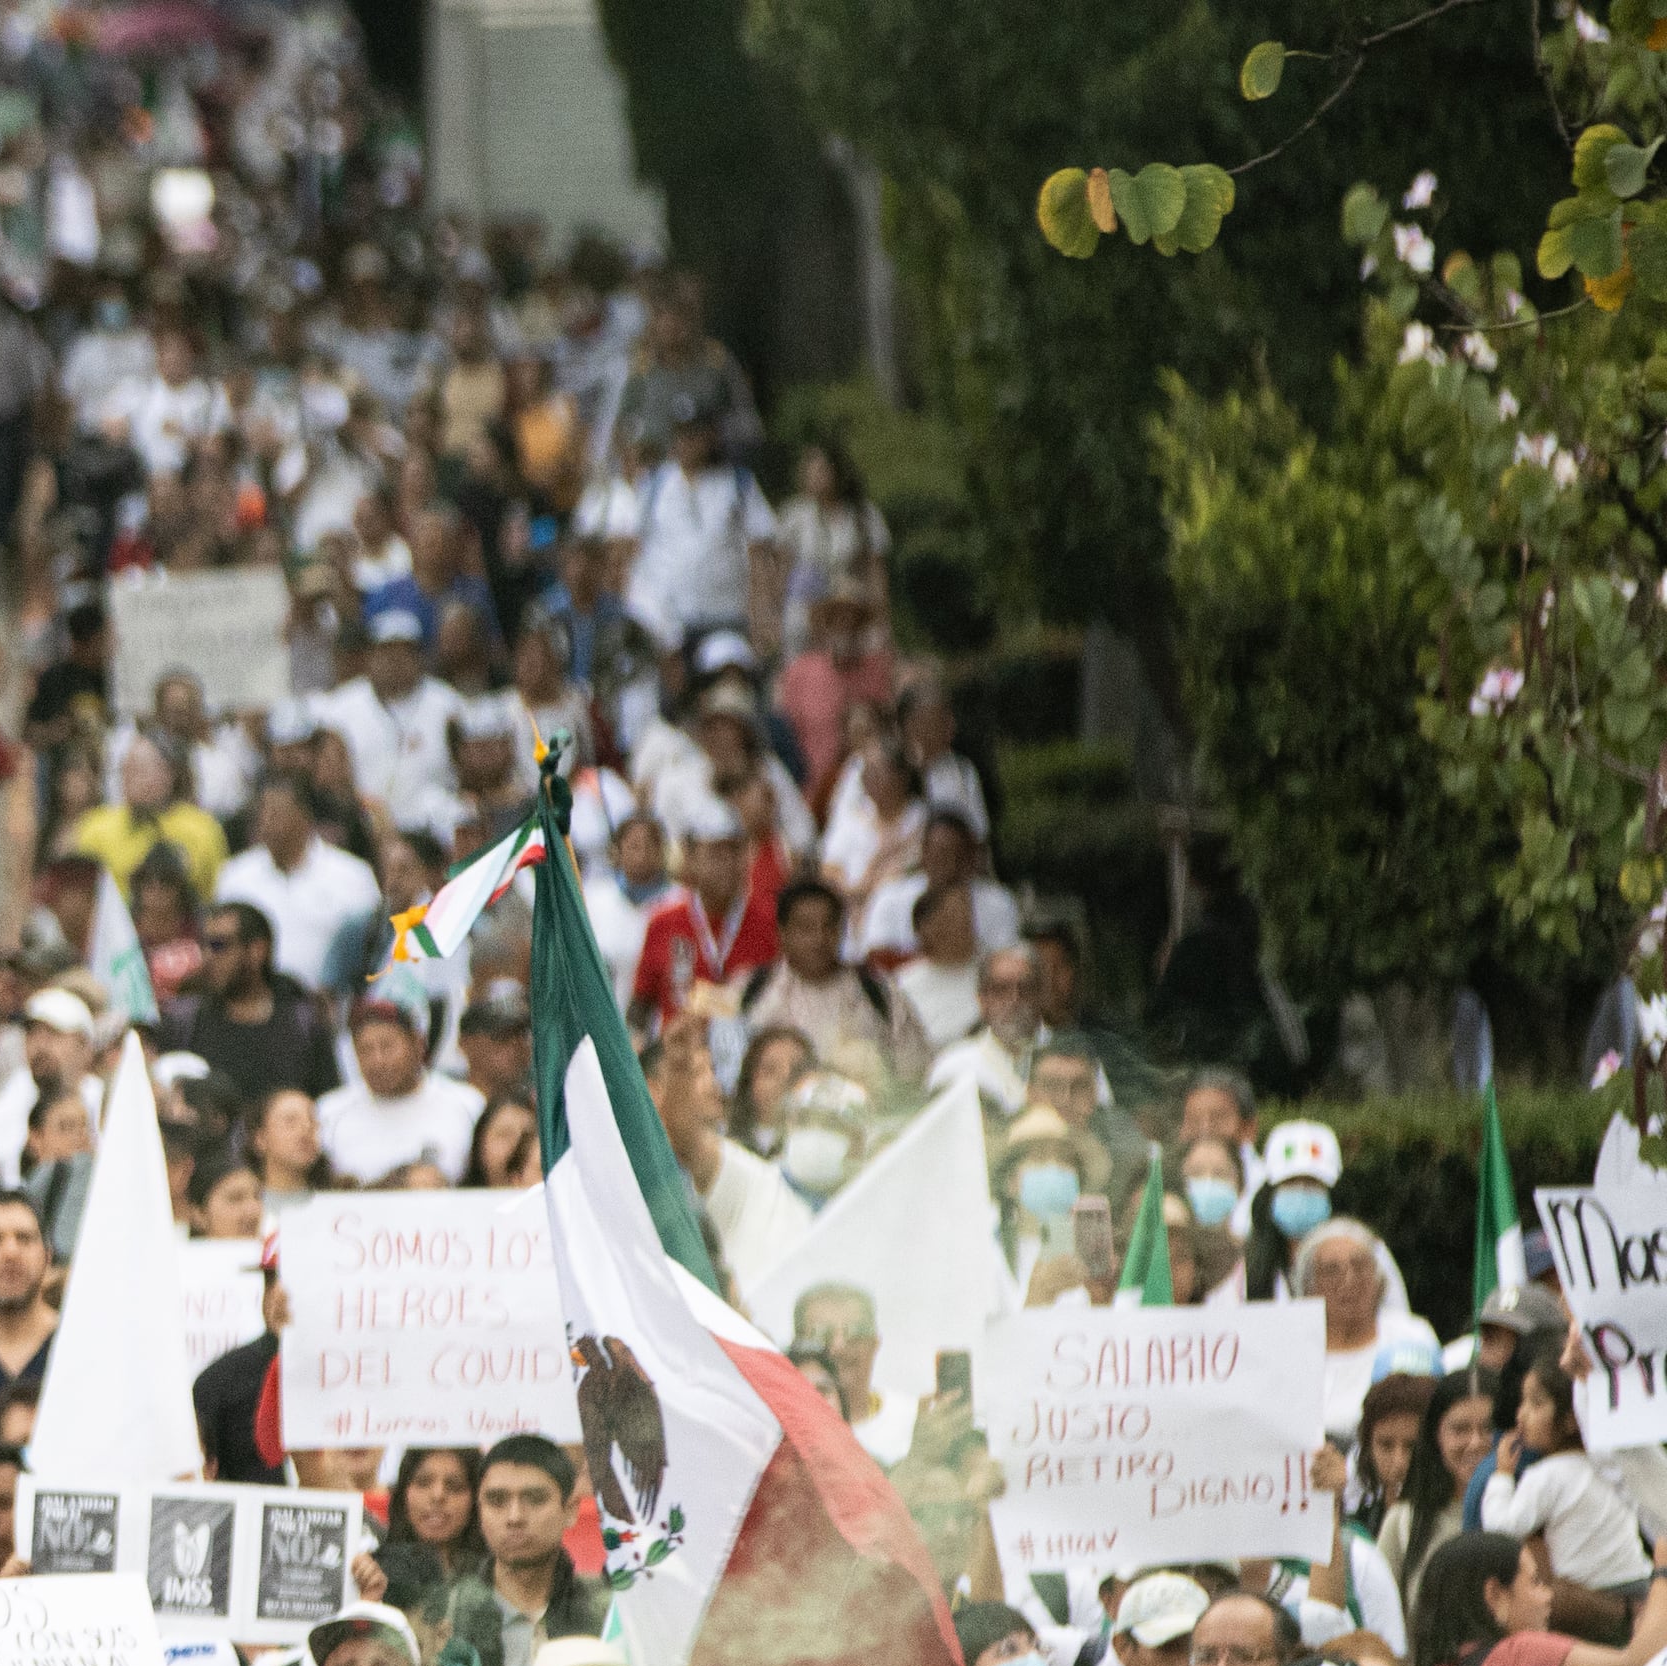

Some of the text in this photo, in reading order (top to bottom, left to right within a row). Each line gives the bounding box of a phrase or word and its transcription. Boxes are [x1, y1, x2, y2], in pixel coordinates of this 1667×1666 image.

[333, 1214, 472, 1271] SOMOS
[317, 1343, 565, 1390] DEL COVID
[1044, 1331, 1241, 1392] SALARIO
[1011, 1401, 1152, 1447] JUSTO
